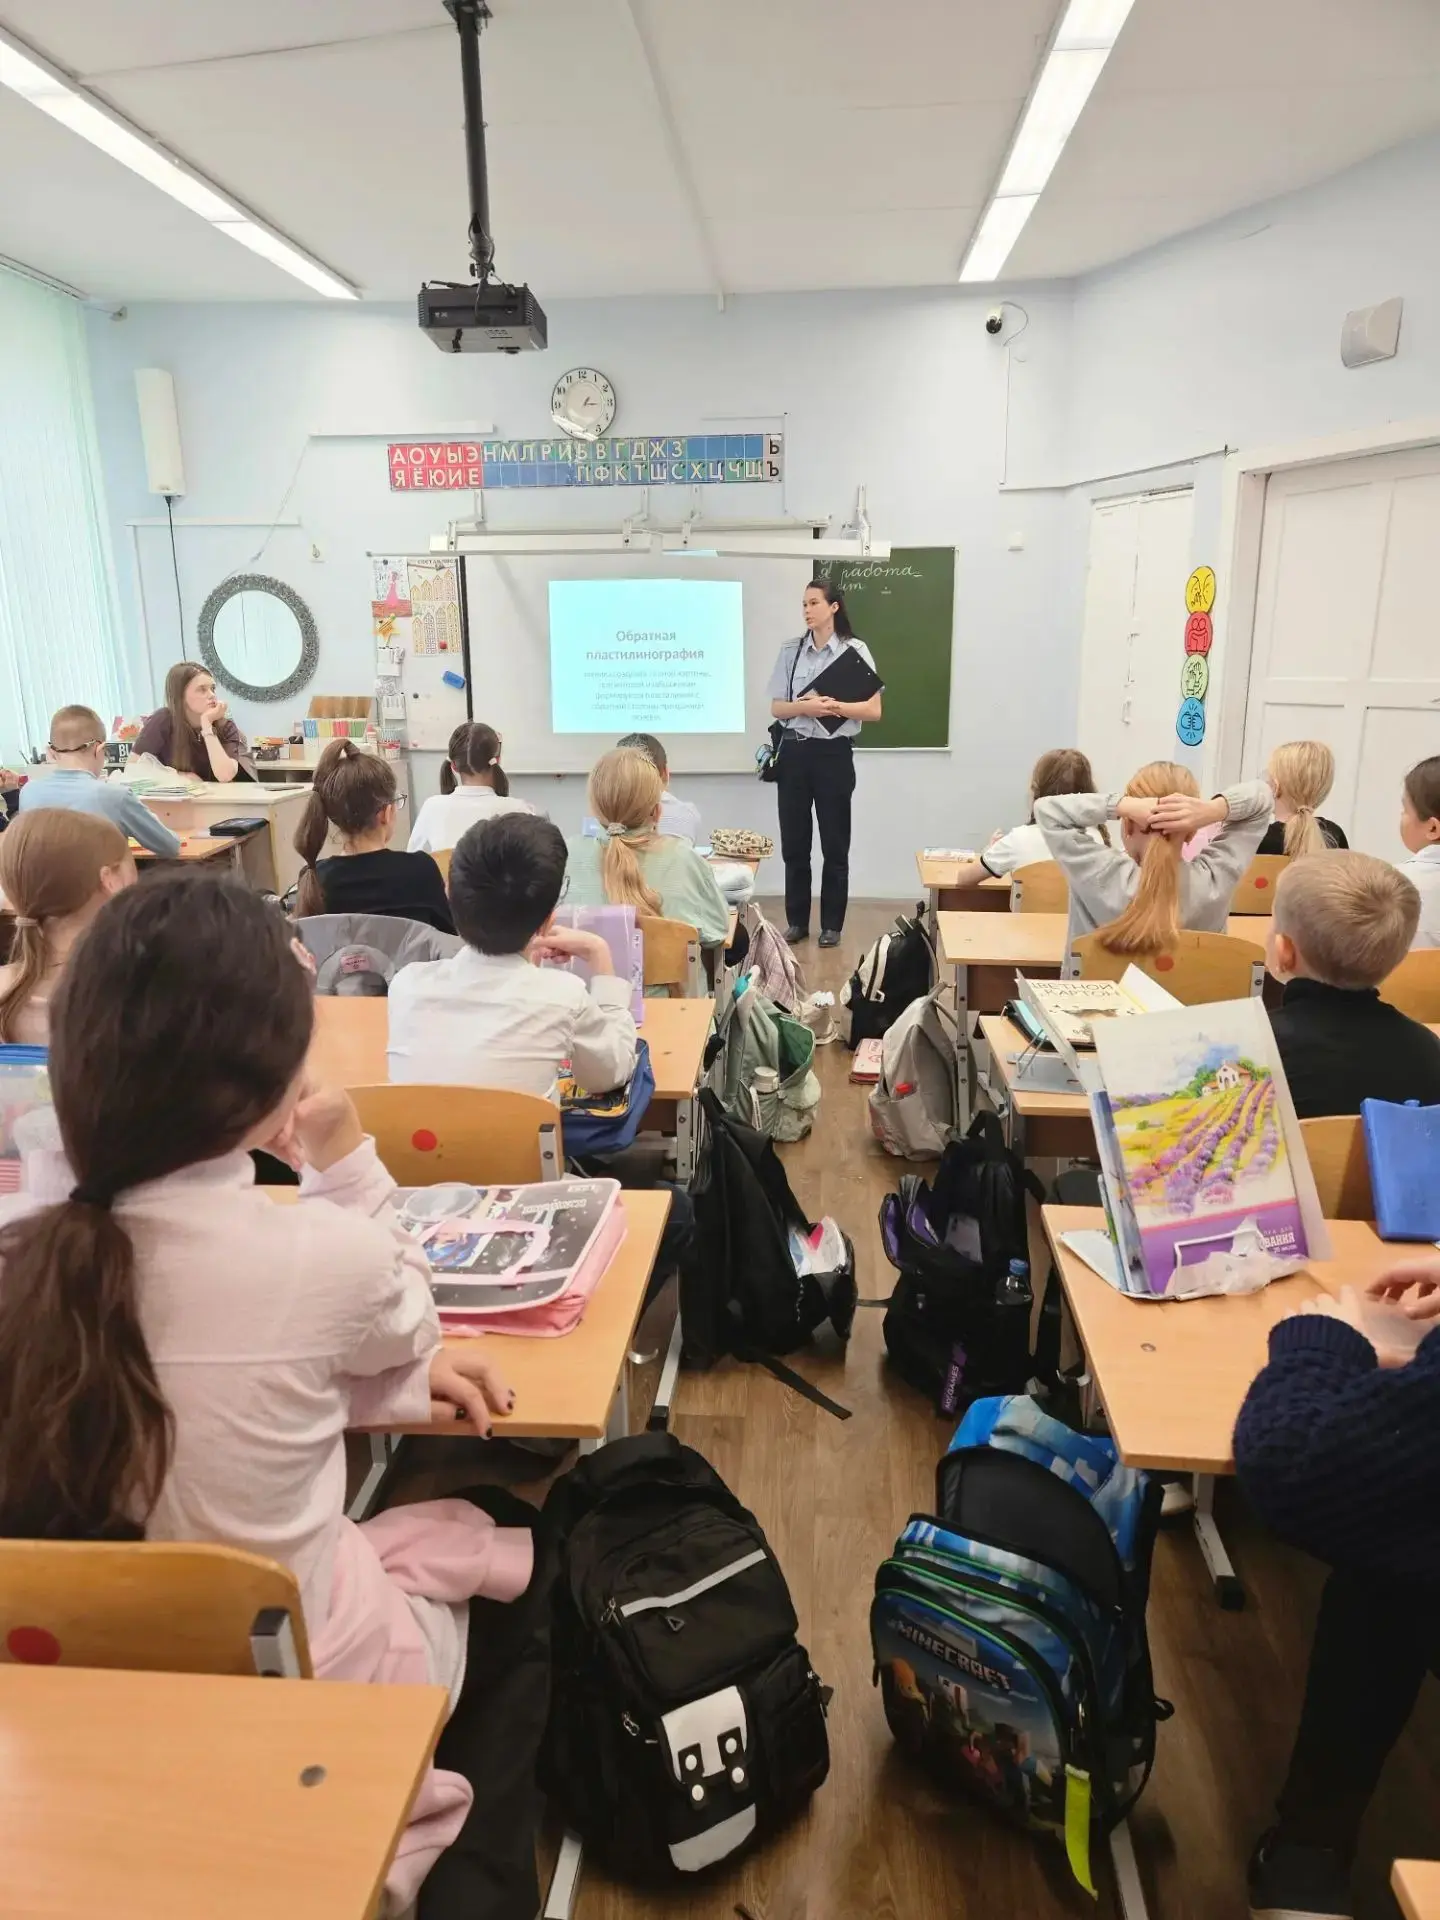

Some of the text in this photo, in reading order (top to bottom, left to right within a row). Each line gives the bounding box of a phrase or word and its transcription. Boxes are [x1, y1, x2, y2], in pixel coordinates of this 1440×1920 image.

[578, 370, 587, 379] 12
[616, 629, 677, 644] Обратная
[586, 648, 705, 662] пластилинография
[899, 1624, 1012, 1690] MINECRAFT
